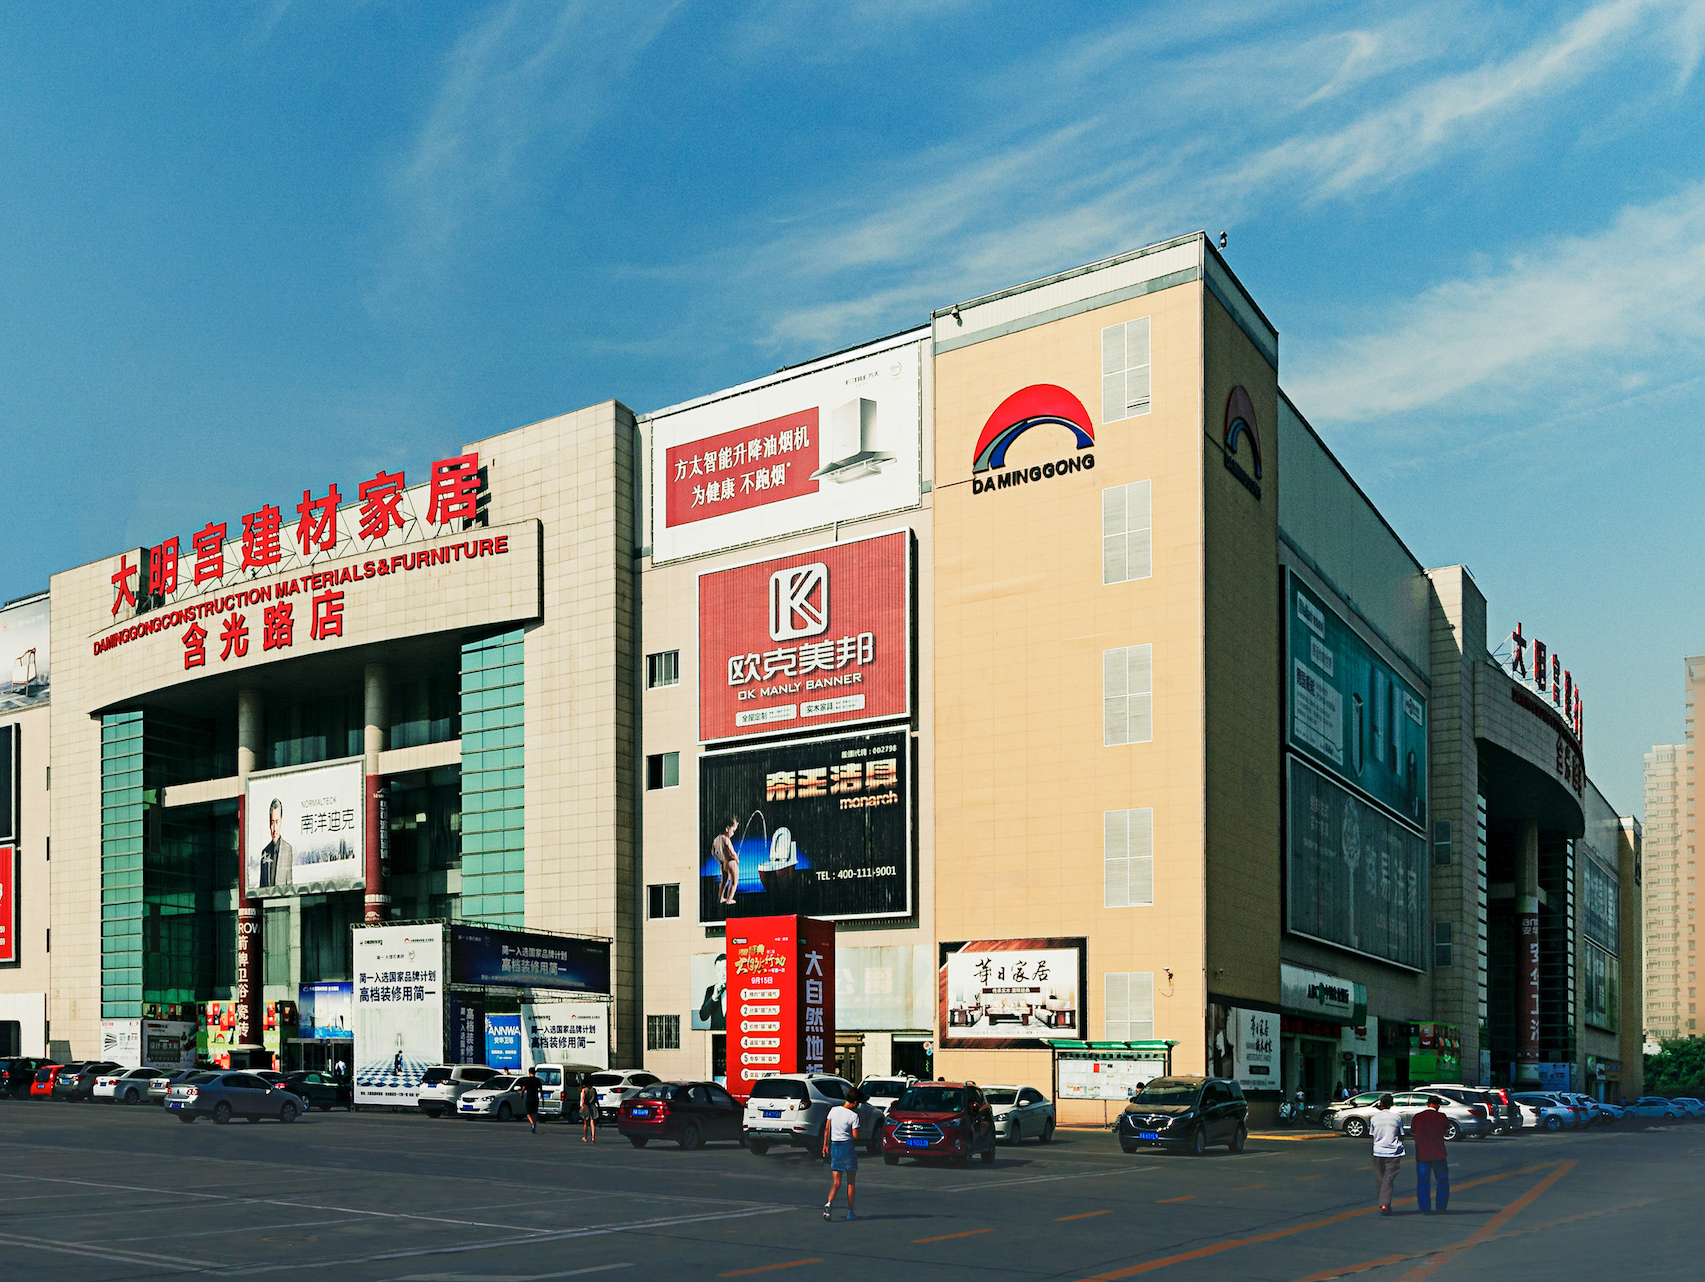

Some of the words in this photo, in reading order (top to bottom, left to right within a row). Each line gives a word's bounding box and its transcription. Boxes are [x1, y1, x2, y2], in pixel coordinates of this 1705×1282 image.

[674, 425, 810, 483] 方太智能升降油烟机
[691, 476, 736, 508] 为健康
[111, 452, 482, 616] 大明宫建材家居
[274, 535, 509, 598] MATERIALS&FURNITURE
[181, 589, 345, 670] 含光路店
[727, 631, 876, 686] 欧克美邦
[738, 689, 756, 701] OK
[760, 681, 802, 698] MANLY
[805, 672, 862, 691] BANNER
[766, 757, 898, 802] 帝王洁具
[840, 789, 899, 810] monarch
[300, 809, 355, 835] 南洋迪克
[501, 945, 568, 961] 简一入选国家品牌计划
[359, 970, 436, 984] 简一入选国家品牌计划
[501, 958, 568, 976] 高档装修用简一
[359, 985, 436, 1002] 高档装修用简一
[488, 1026, 521, 1036] ANNWA
[531, 1025, 596, 1035] 简一入选国家品牌计划
[531, 1036, 596, 1050] 高档装修用简一
